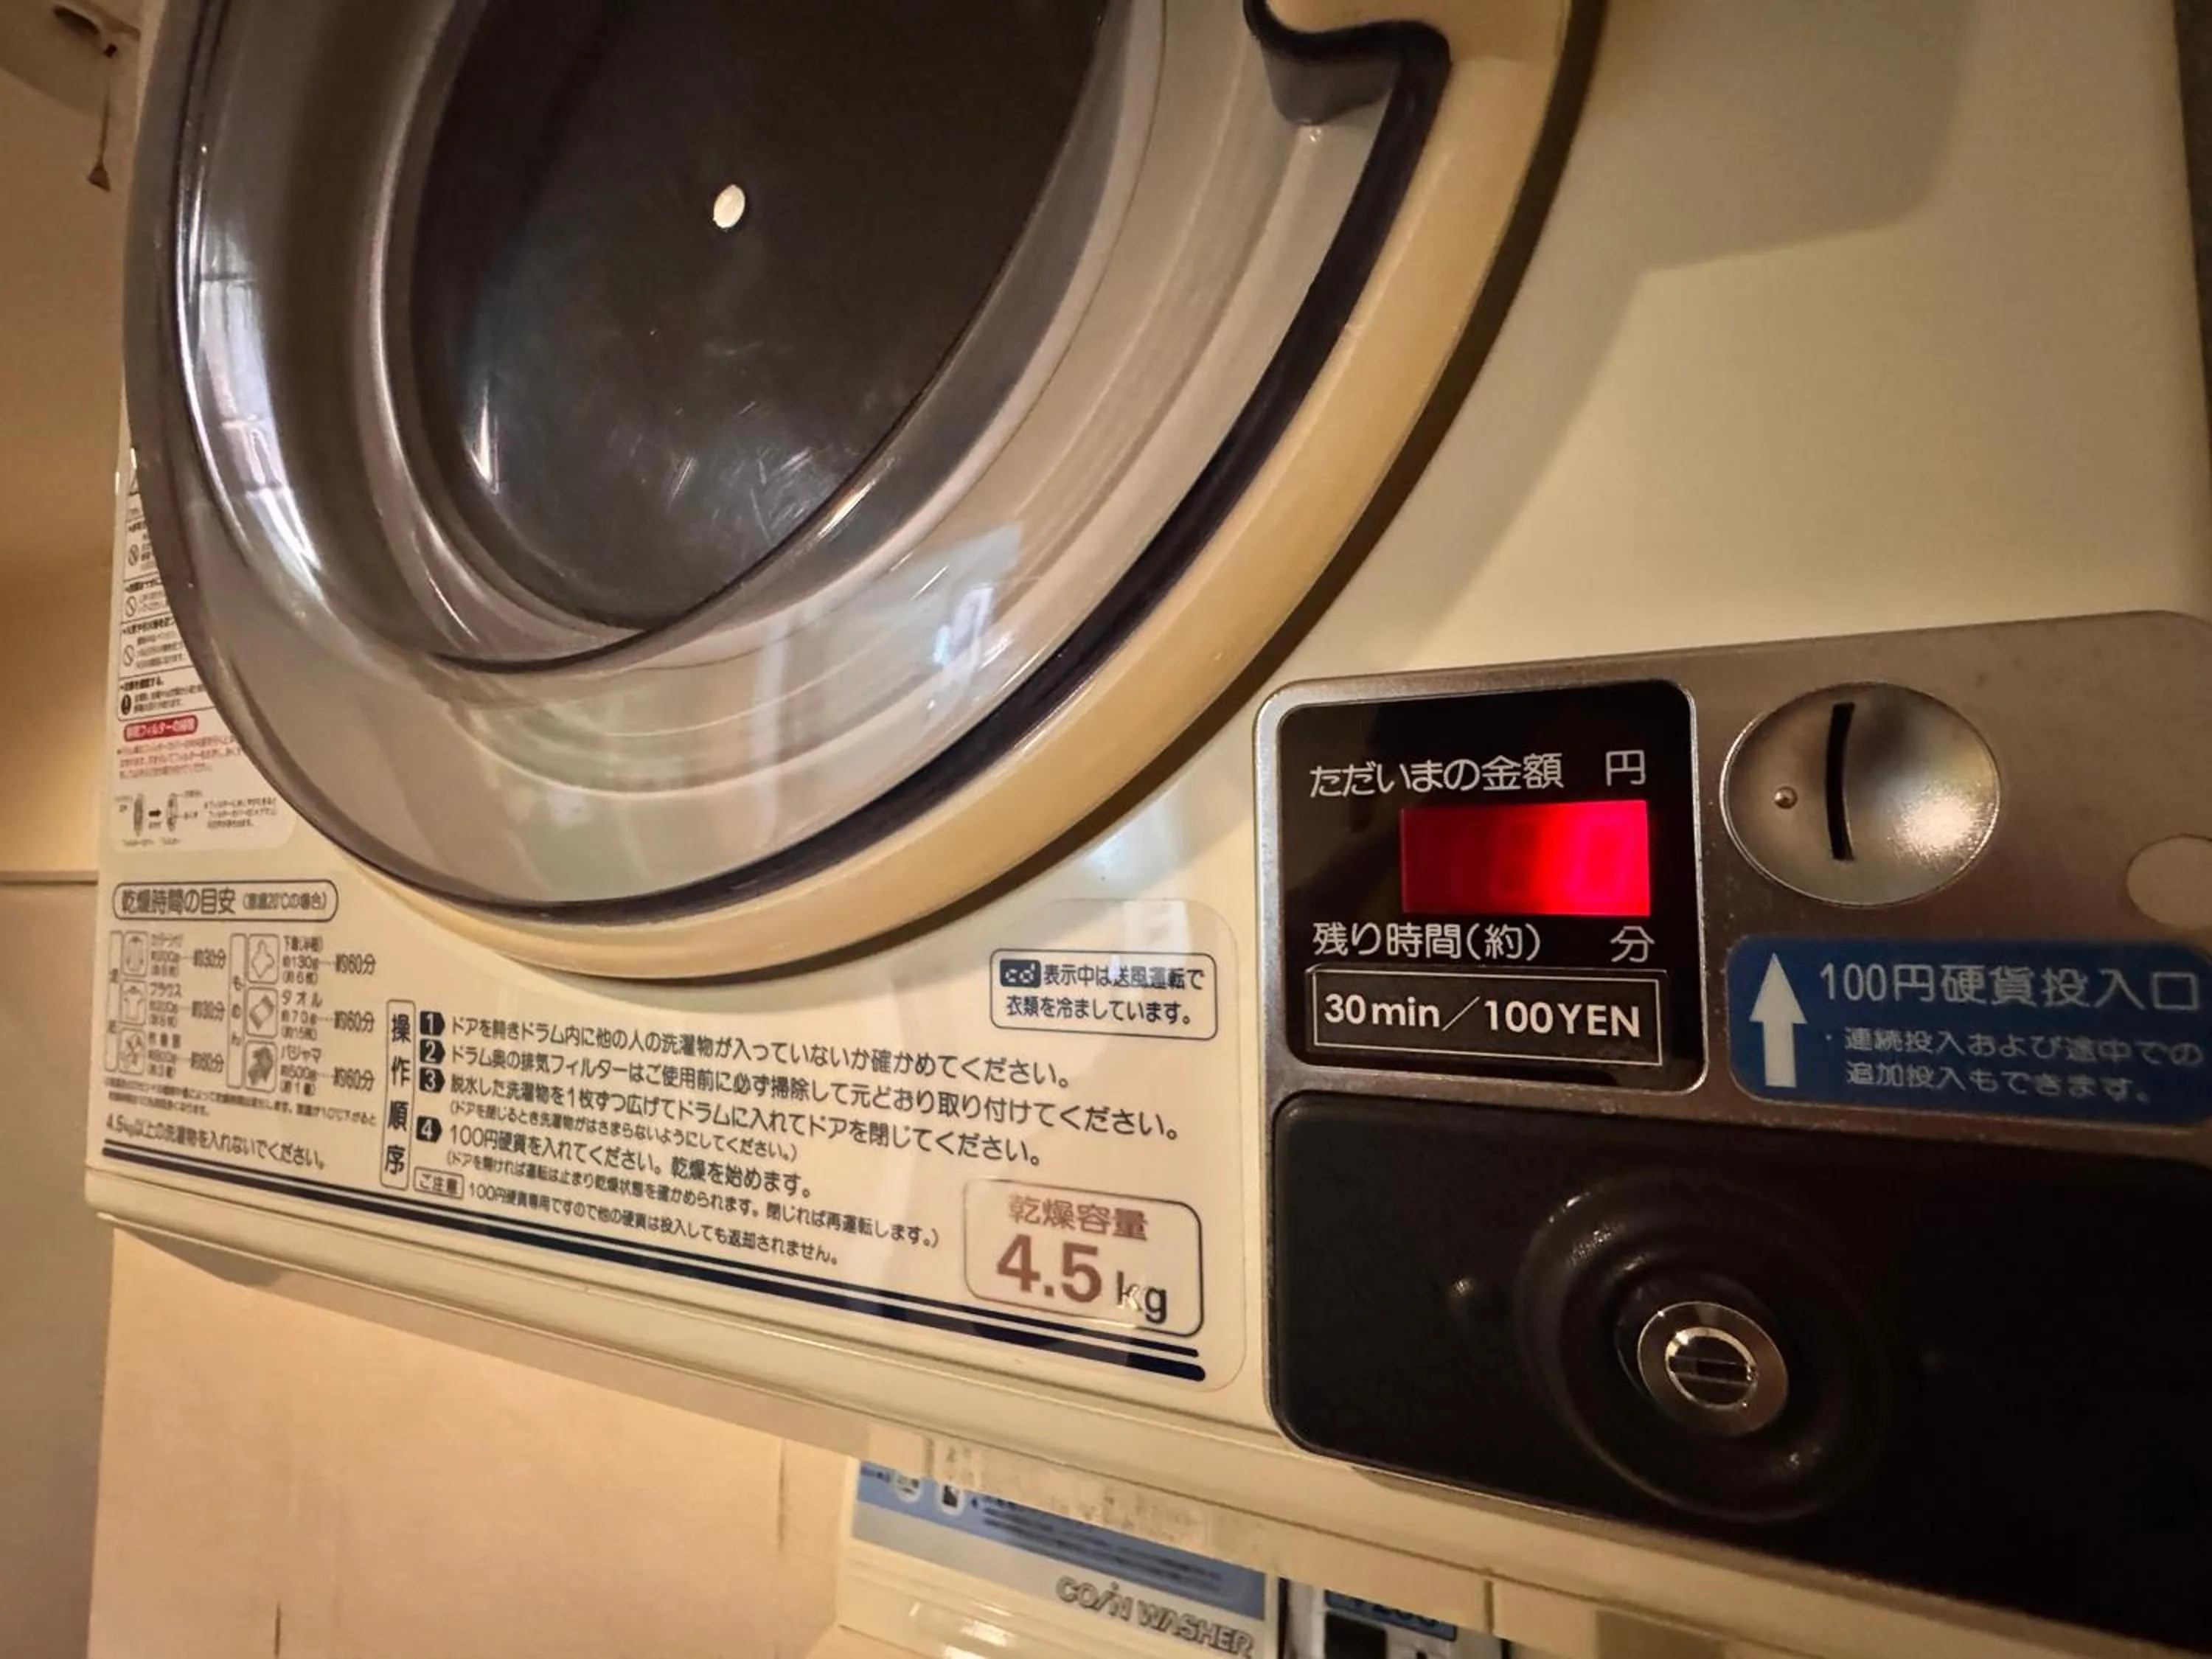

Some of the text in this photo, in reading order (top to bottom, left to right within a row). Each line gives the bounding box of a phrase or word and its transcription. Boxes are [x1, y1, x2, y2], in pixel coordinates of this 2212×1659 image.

[1309, 749, 1646, 799] ただいまの金額 円
[335, 953, 377, 975] 約60分
[1312, 921, 1655, 963] 残り時間(約) 分
[282, 989, 323, 1008] タオル
[1006, 995, 1191, 1025] 衣類を冷ましています。
[1819, 961, 2200, 1012] 100円硬貨投入口
[333, 1010, 375, 1033] 約60分
[451, 1015, 1070, 1088] ドアを開きドラム内に他の人の洗濯物が入っていないか確かめてください。
[333, 1066, 375, 1092] 約60分
[384, 1014, 411, 1175] 操作順序
[451, 1045, 1178, 1141] ドラム奥の排気フィルターはご使用前に必ず掃除して元どおり取り付けてください。
[1845, 1061, 2150, 1103] 追加投入もできます。
[451, 1073, 1041, 1166] 脱水した洗濯物を1枚ずつ広げてドラムに入れてドアを閉じてください。
[1007, 1193, 1149, 1242] 乾燥容量
[995, 1233, 1168, 1324] 4.5 kg
